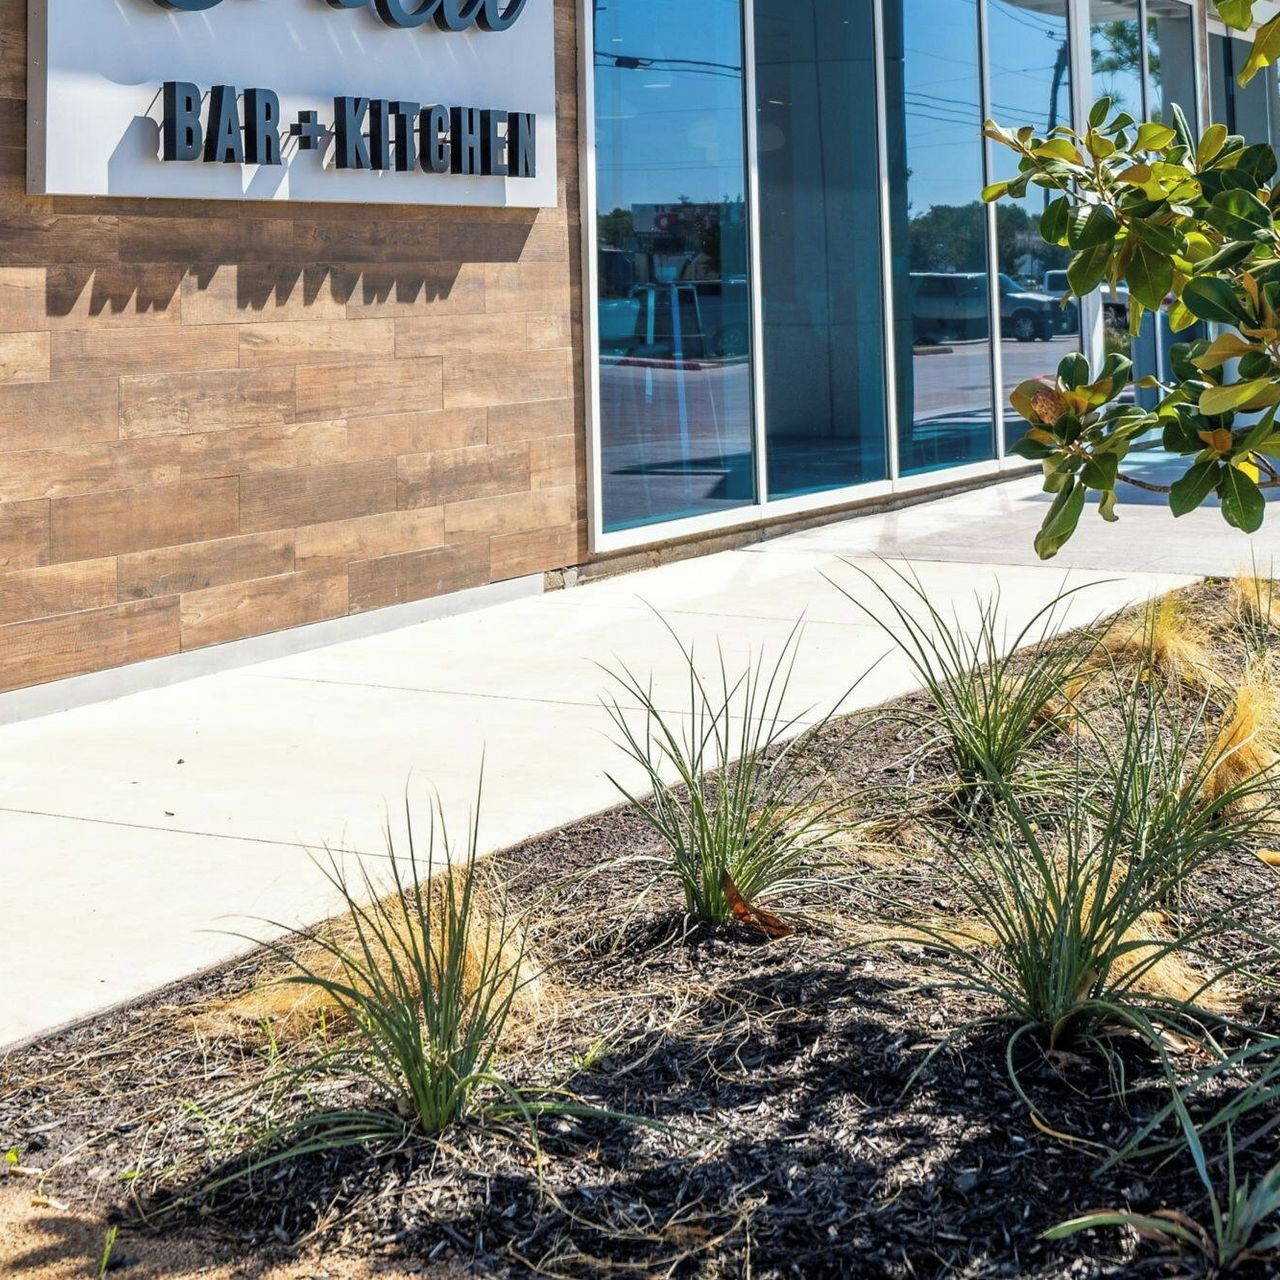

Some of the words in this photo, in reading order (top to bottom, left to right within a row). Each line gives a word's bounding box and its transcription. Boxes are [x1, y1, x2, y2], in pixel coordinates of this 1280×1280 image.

[163, 81, 282, 165] BAR
[290, 110, 325, 150] +
[334, 96, 536, 178] KITCHEN
